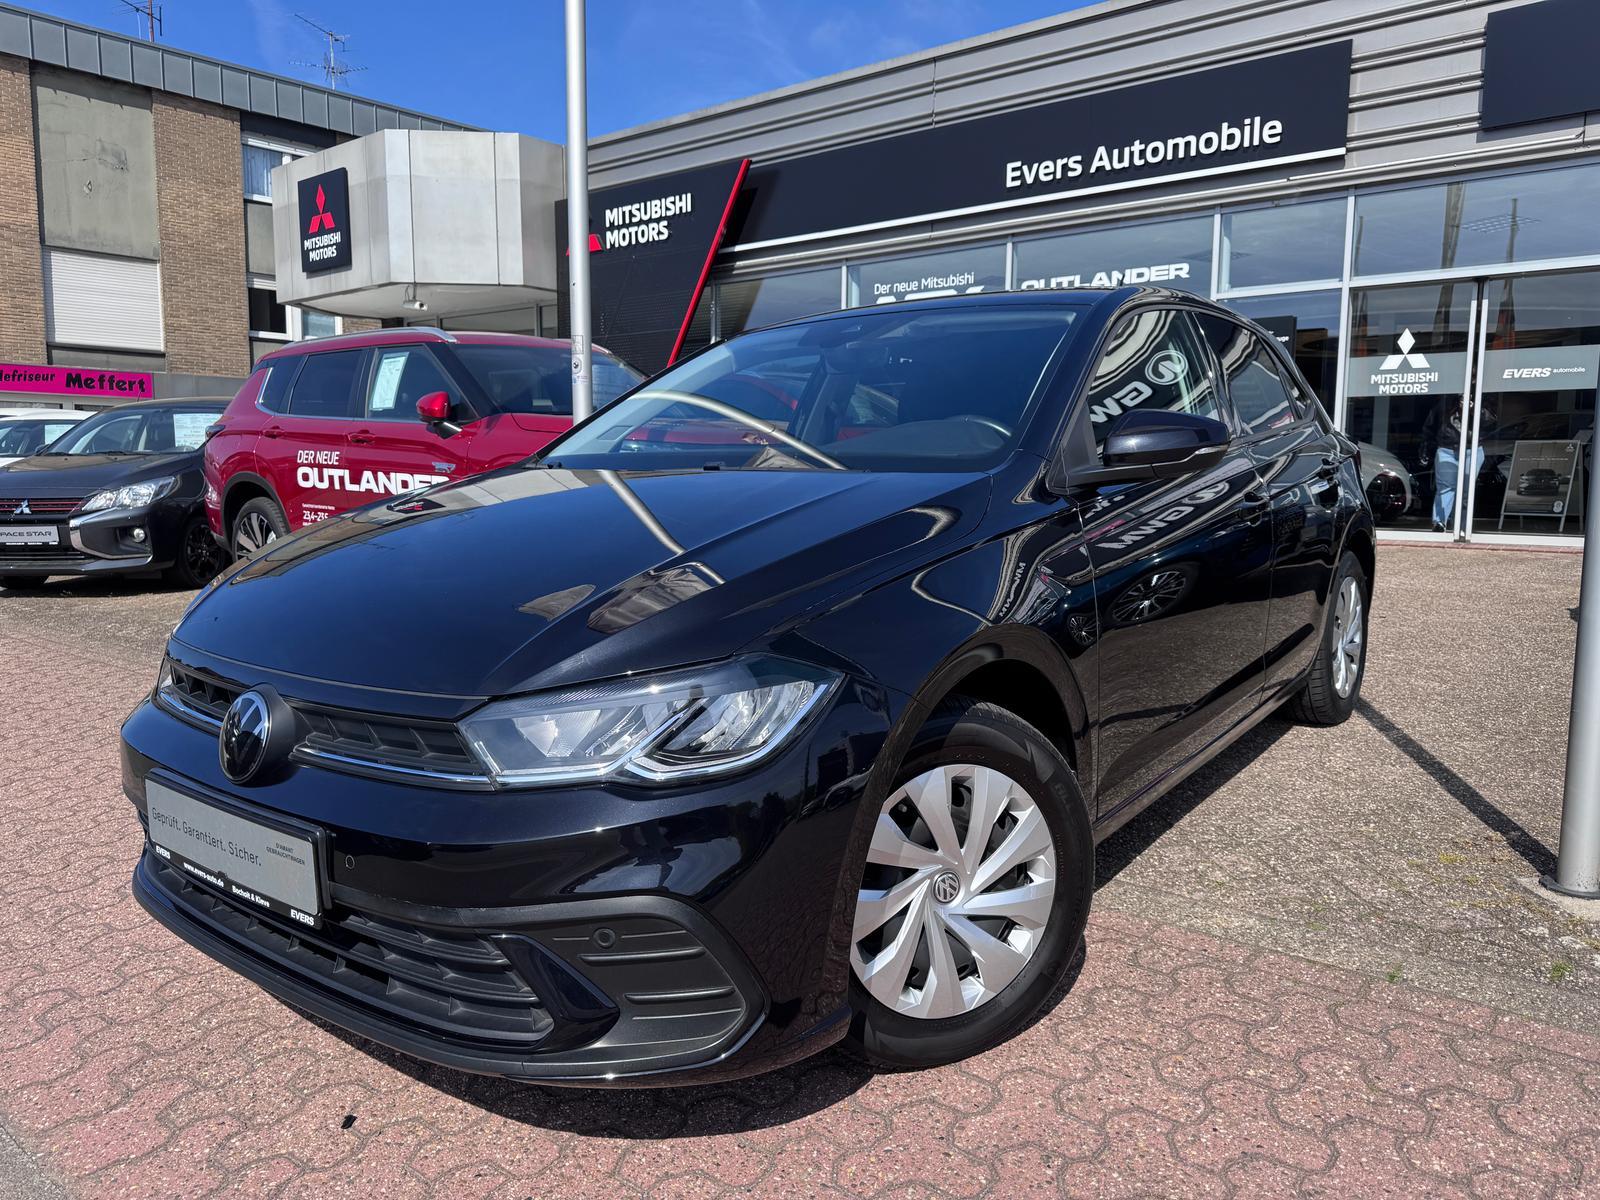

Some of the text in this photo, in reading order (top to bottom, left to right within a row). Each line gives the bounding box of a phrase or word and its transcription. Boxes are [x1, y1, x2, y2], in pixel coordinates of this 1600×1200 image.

[1005, 116, 1283, 188] Evers Automobile
[605, 193, 692, 228] MITSUBISHI
[303, 231, 342, 251] MITSUBISHI
[605, 220, 669, 250] MOTORS
[309, 245, 337, 262] MOTORS
[874, 283, 891, 295] Der
[893, 281, 918, 293] neue
[921, 271, 975, 290] Mitsubishi
[65, 372, 146, 393] Meffert
[1370, 372, 1439, 385] MITSUBISHI
[1502, 366, 1586, 379] EVERS automobile
[1378, 383, 1429, 395] MOTORS
[296, 449, 341, 465] DER NEUE
[151, 807, 262, 867] Geprüft. Garantiert. Sicher.
[155, 845, 171, 860] EVERS
[290, 908, 315, 926] EVERS
